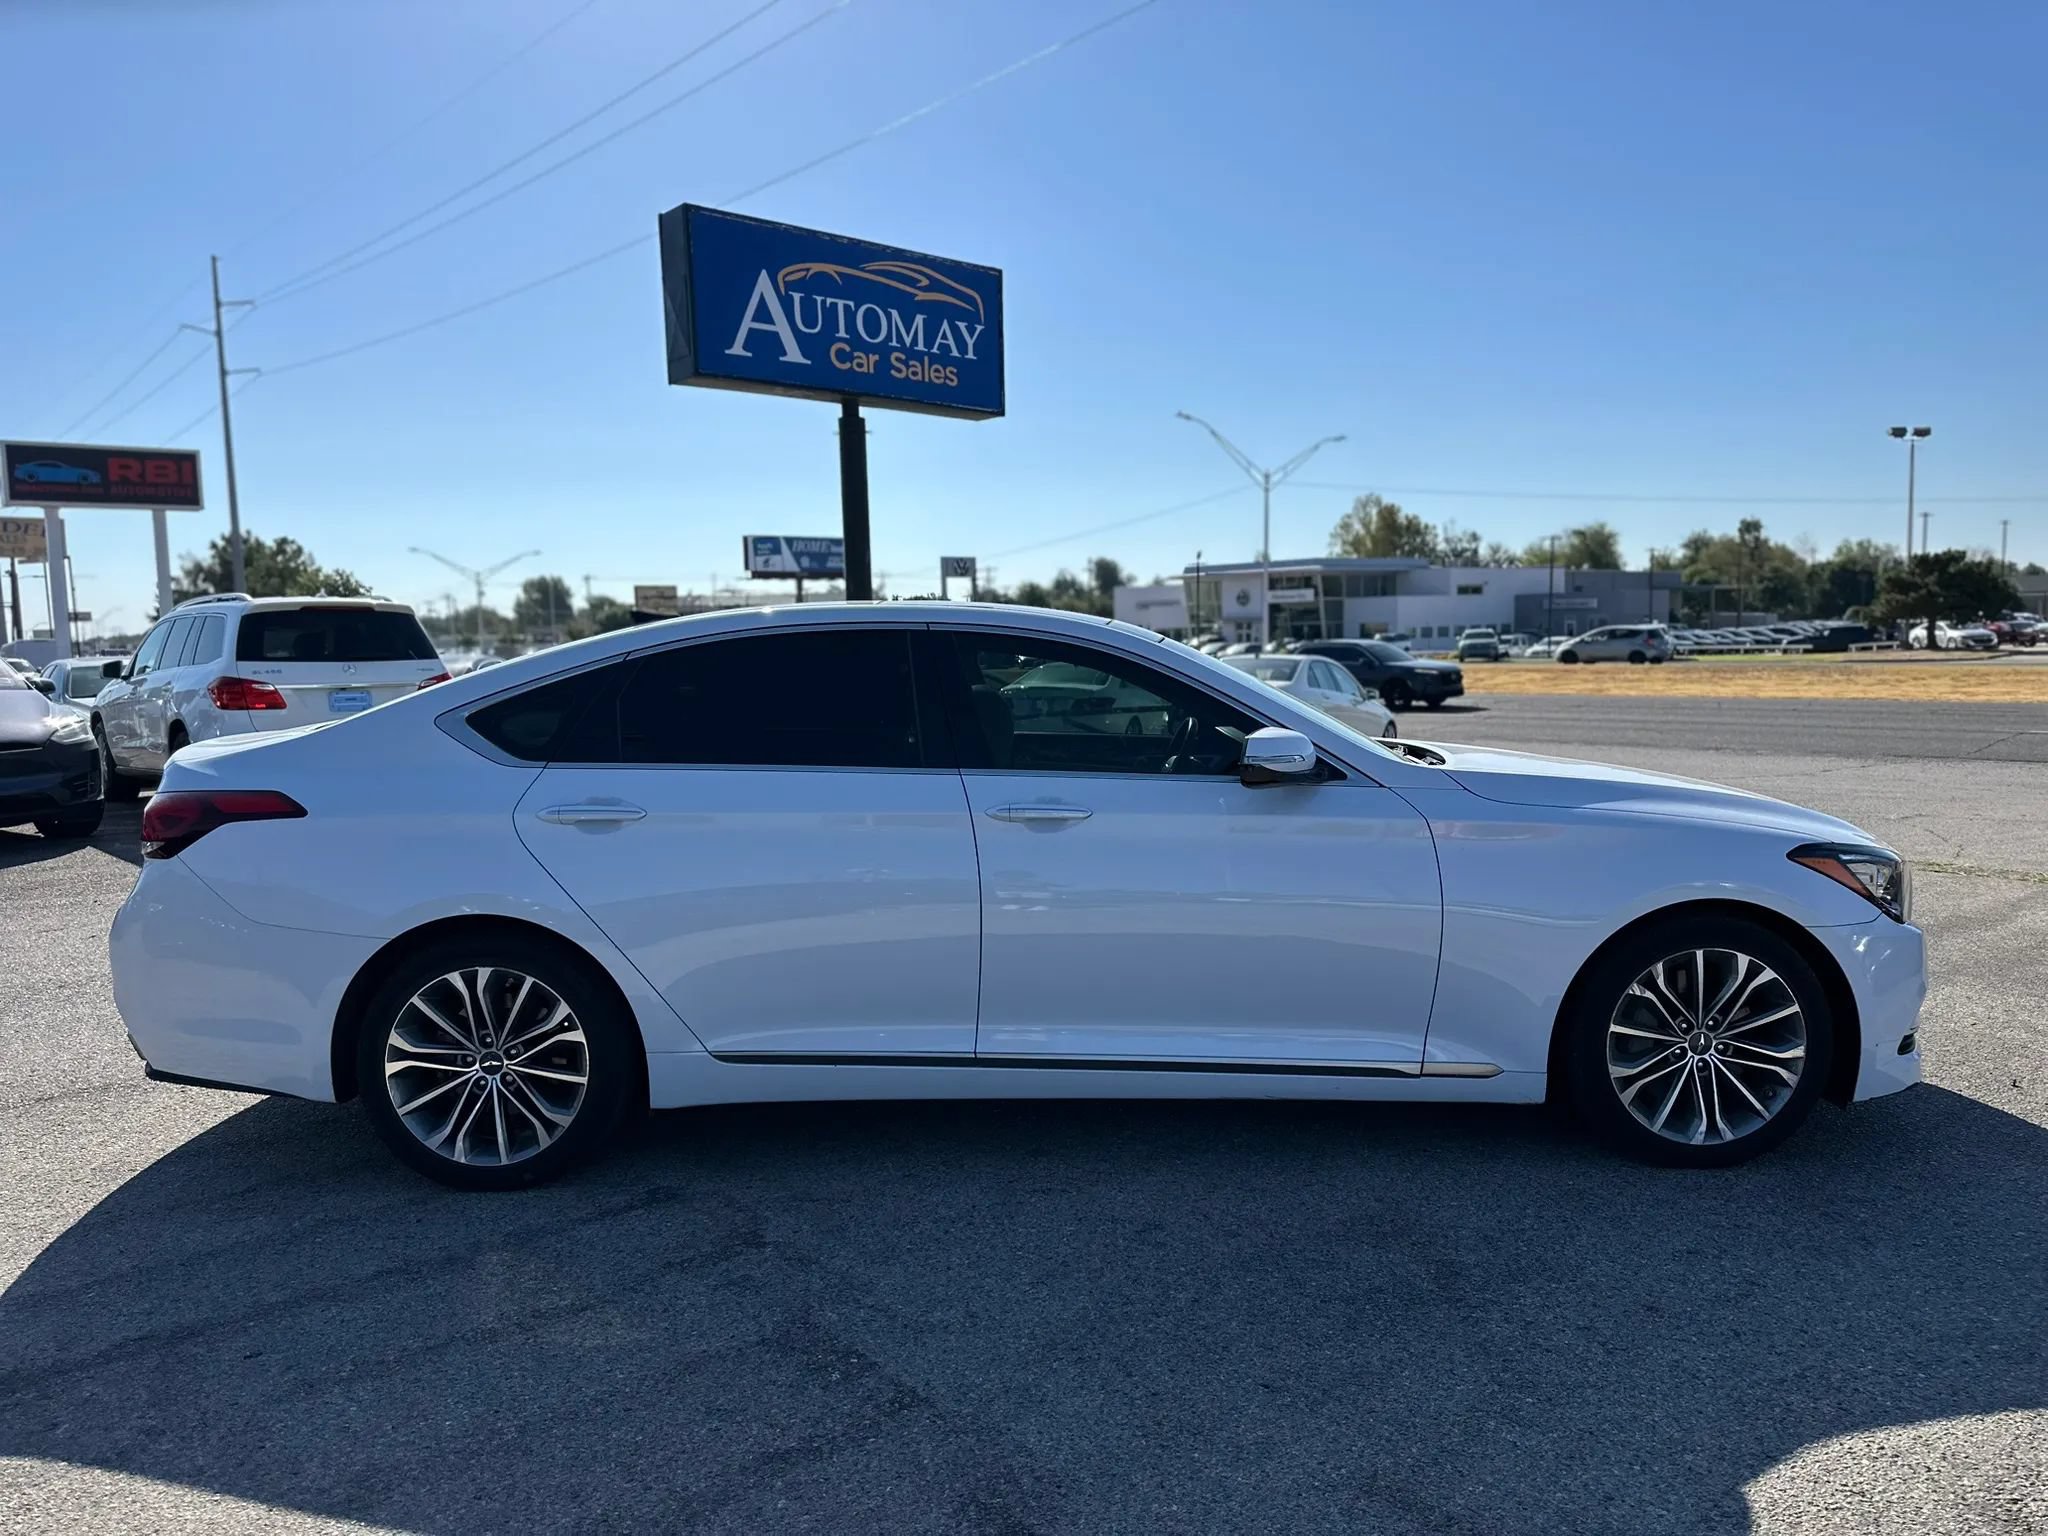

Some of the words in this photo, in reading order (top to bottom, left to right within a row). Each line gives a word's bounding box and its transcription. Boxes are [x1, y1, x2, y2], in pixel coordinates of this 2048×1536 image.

[725, 269, 985, 365] AUTOMAY
[830, 343, 879, 374] Car
[890, 352, 959, 387] Sales
[107, 457, 193, 484] RBI
